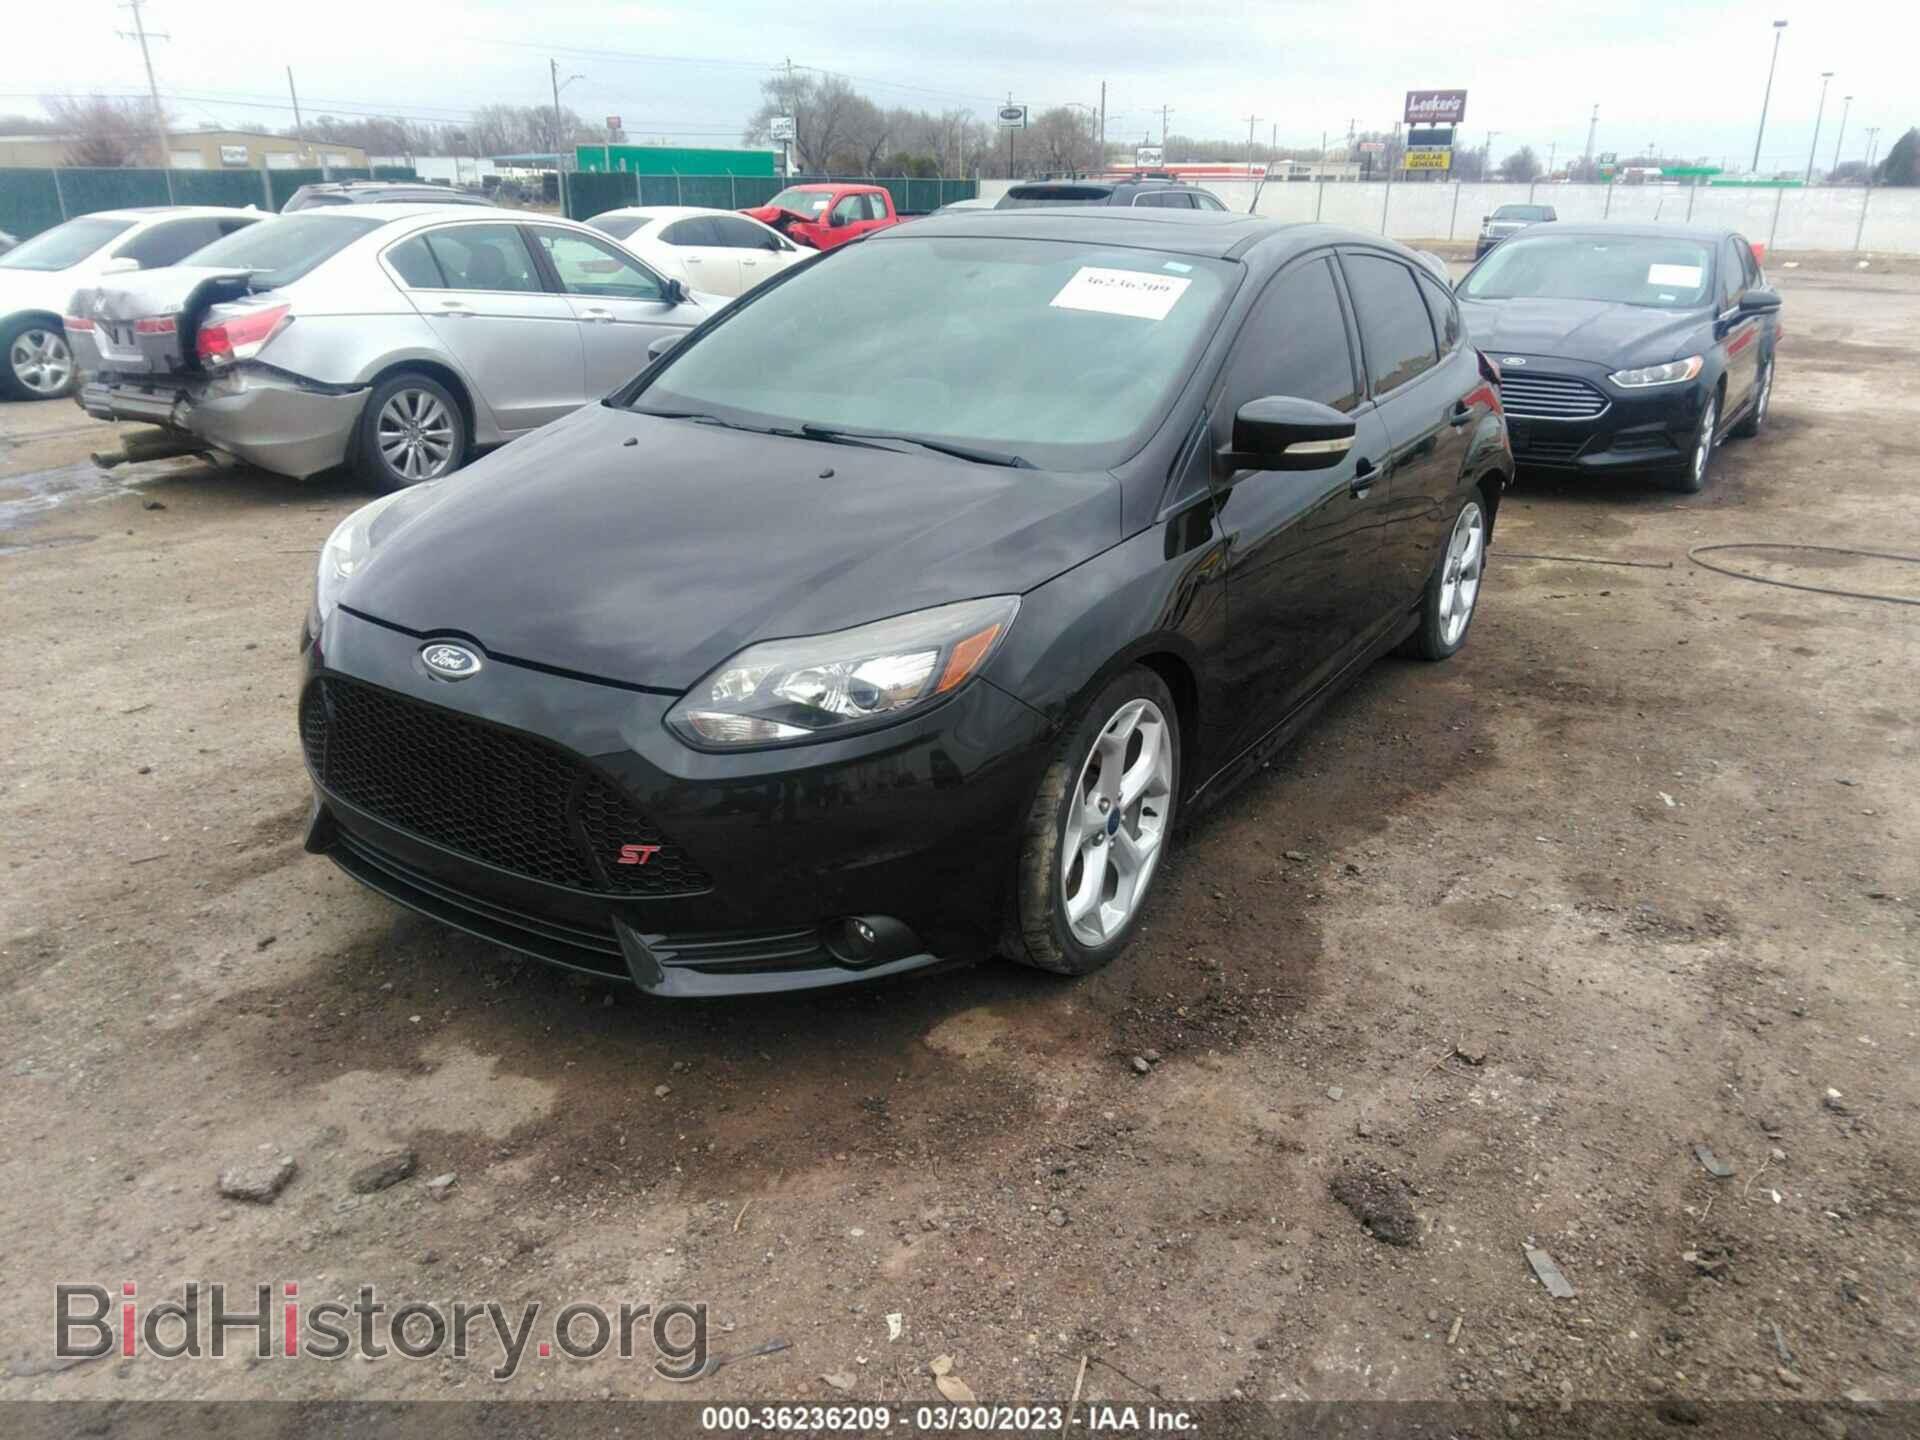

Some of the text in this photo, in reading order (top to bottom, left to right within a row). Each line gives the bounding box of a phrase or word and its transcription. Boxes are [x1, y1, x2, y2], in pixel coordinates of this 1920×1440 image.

[1409, 160, 1442, 168] GENERAL
[430, 647, 466, 669] Ford
[617, 844, 661, 865] ST
